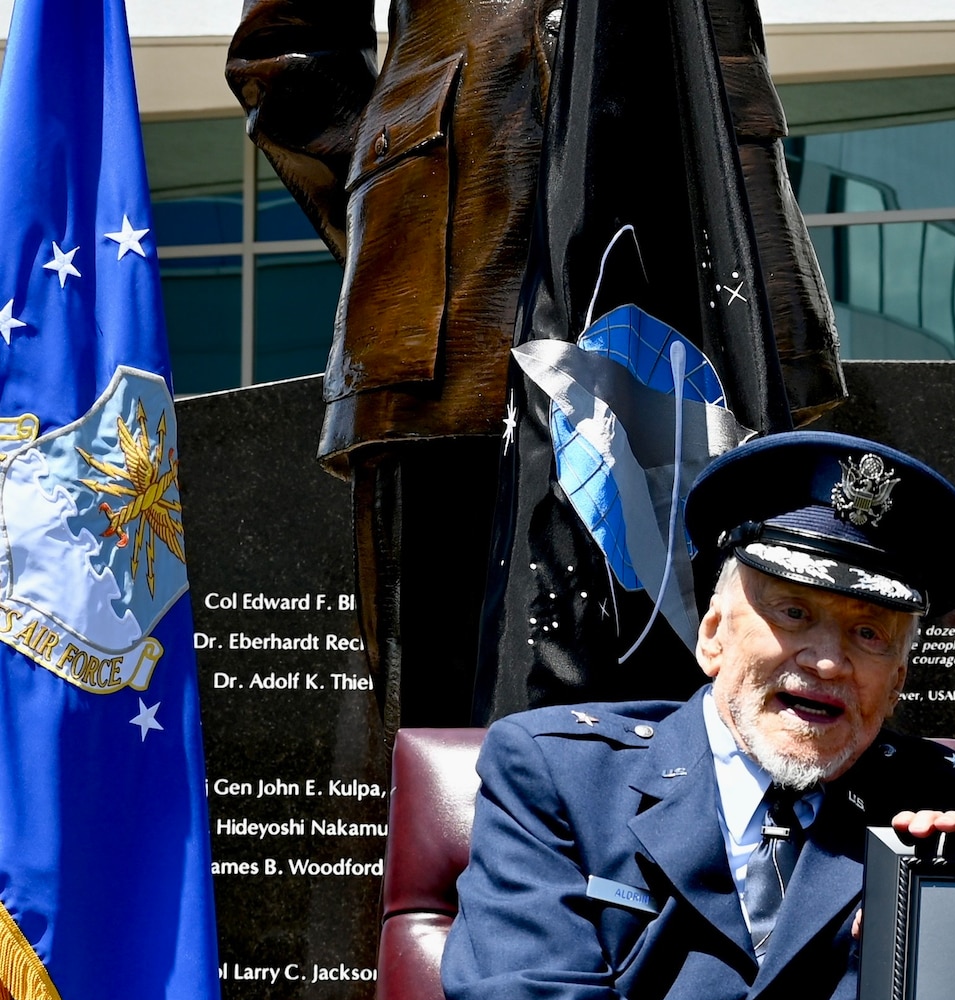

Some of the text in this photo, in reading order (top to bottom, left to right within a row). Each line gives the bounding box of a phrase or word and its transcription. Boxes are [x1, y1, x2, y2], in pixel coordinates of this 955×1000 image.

[204, 592, 237, 610] Col
[242, 593, 310, 610] Edward
[316, 594, 332, 611] F.
[193, 632, 222, 650] Dr.
[229, 633, 320, 650] Eberhardt
[14, 619, 60, 662] AIR
[56, 642, 124, 688] FORCE
[214, 672, 244, 690] Dr.
[249, 672, 300, 690] Adolf
[306, 673, 325, 690] K.
[214, 778, 252, 796] Gen
[256, 778, 300, 798] John
[306, 779, 323, 796] E.
[328, 779, 386, 801] Kulpa,
[216, 818, 304, 840] Hideyoshi
[264, 858, 284, 876] B.
[288, 858, 384, 876] Woodford
[614, 888, 651, 904] ALDRIN
[234, 962, 280, 985] Larry
[284, 964, 306, 980] C.
